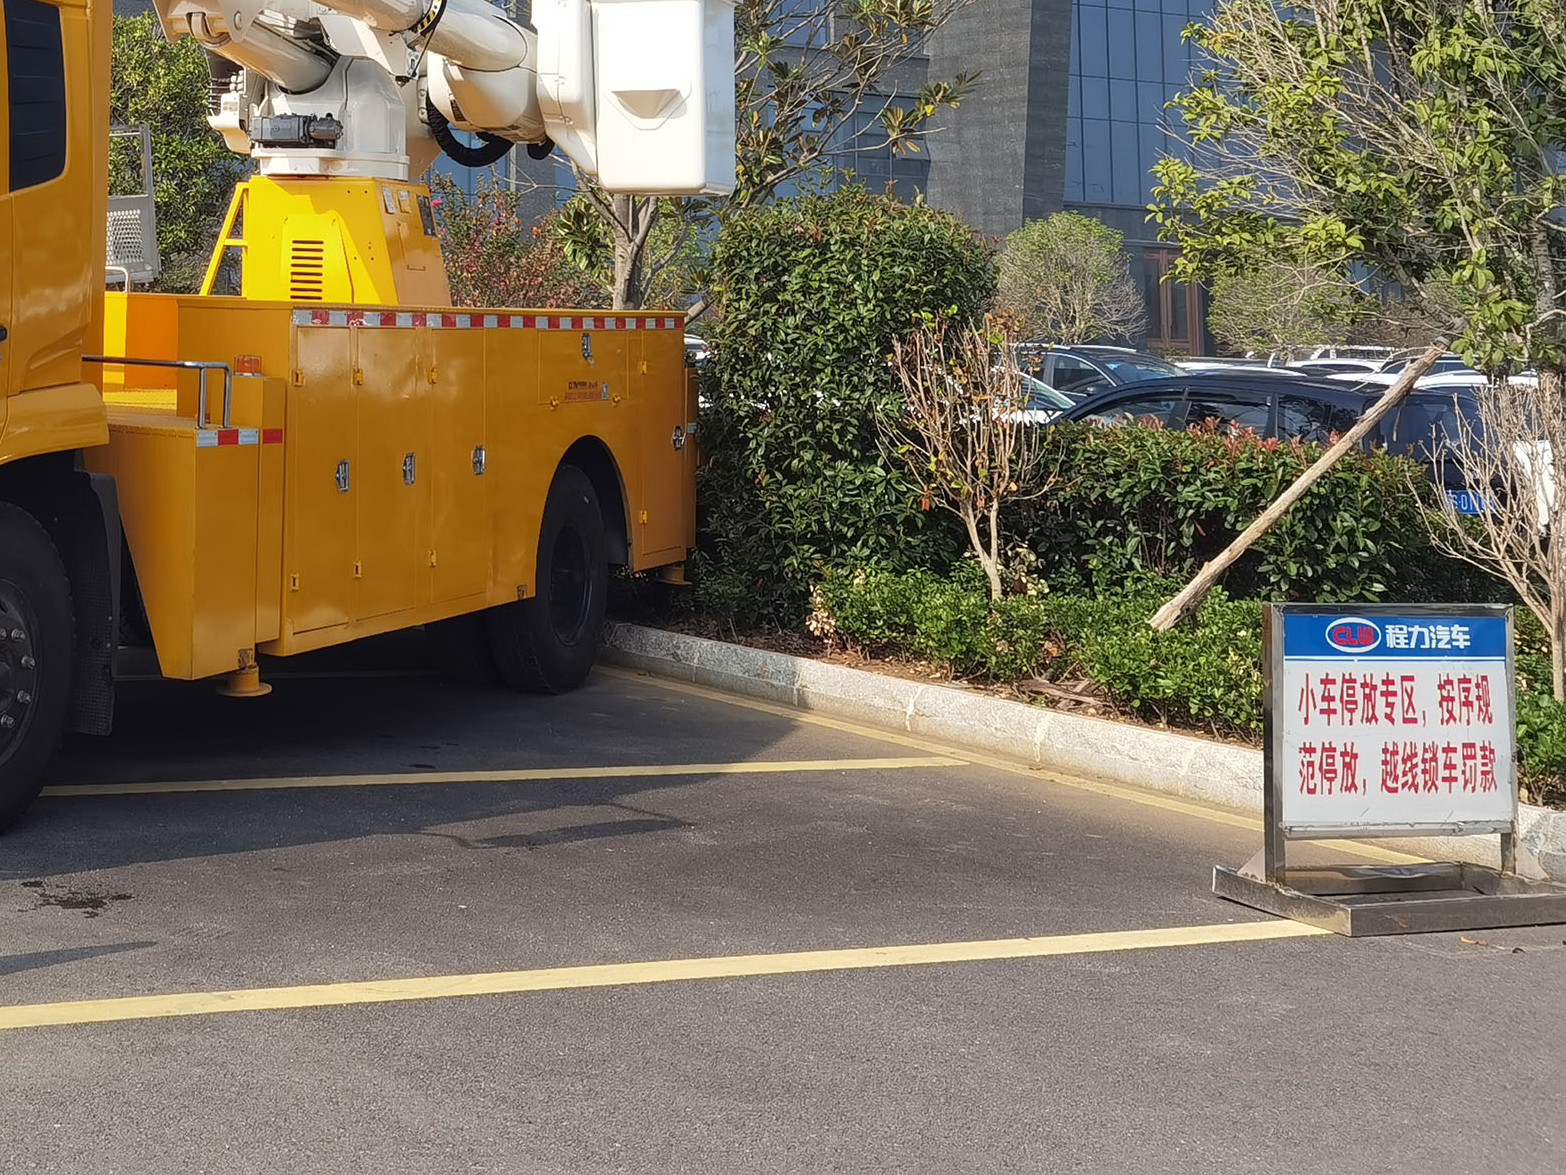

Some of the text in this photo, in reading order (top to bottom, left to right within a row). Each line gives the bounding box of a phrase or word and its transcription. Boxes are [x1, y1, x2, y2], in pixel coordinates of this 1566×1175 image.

[1332, 624, 1471, 649] CLW 程力汽车
[1298, 672, 1493, 727] 小车停放专区，按序规
[1298, 740, 1498, 796] 范停放，越线锁车罚款
